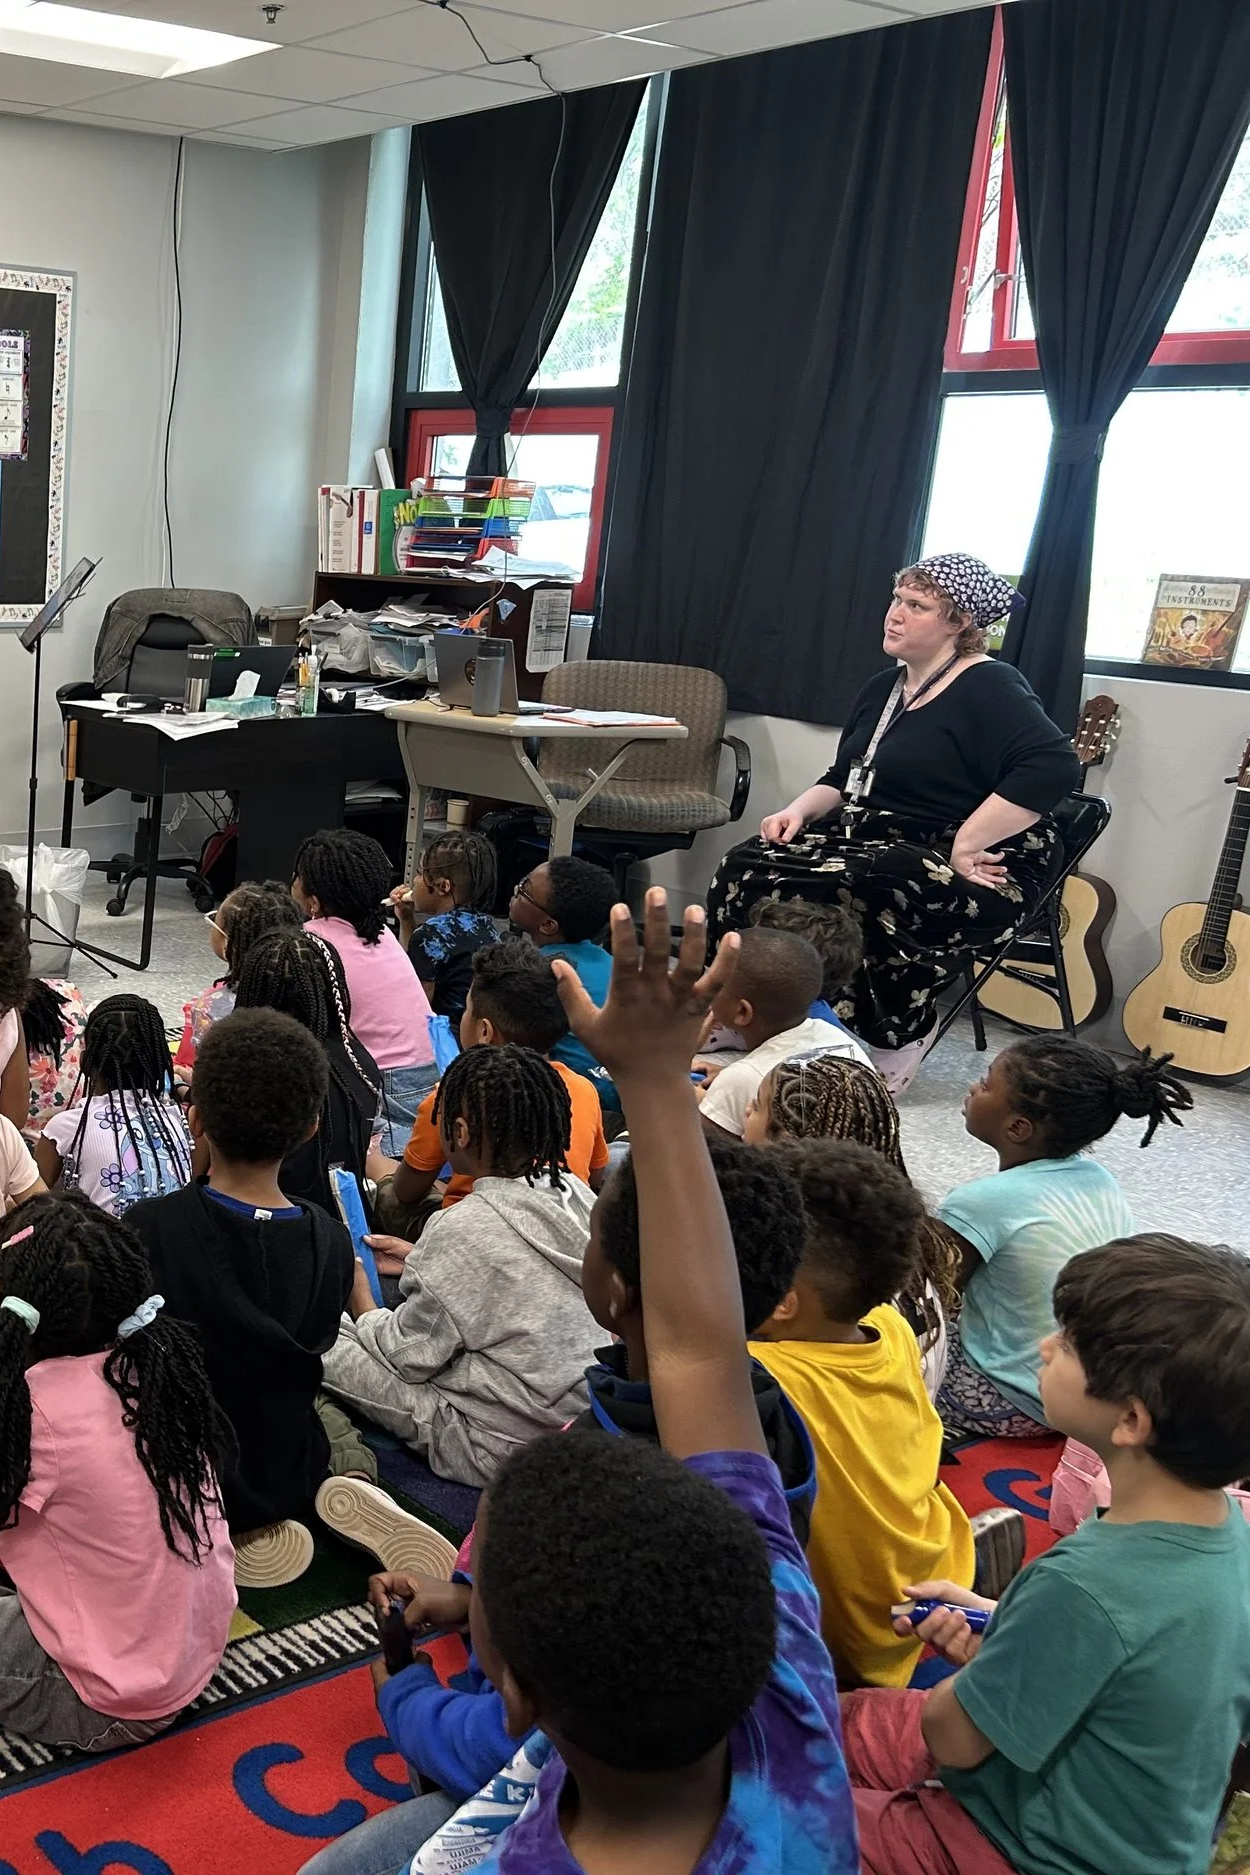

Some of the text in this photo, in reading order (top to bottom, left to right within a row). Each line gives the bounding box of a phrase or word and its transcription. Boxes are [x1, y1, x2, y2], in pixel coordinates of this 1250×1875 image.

[1188, 585, 1206, 597] 88
[1166, 595, 1232, 608] INSTRUMENTS
[450, 1846, 481, 1858] UJIMA
[450, 1857, 480, 1870] UJAM
